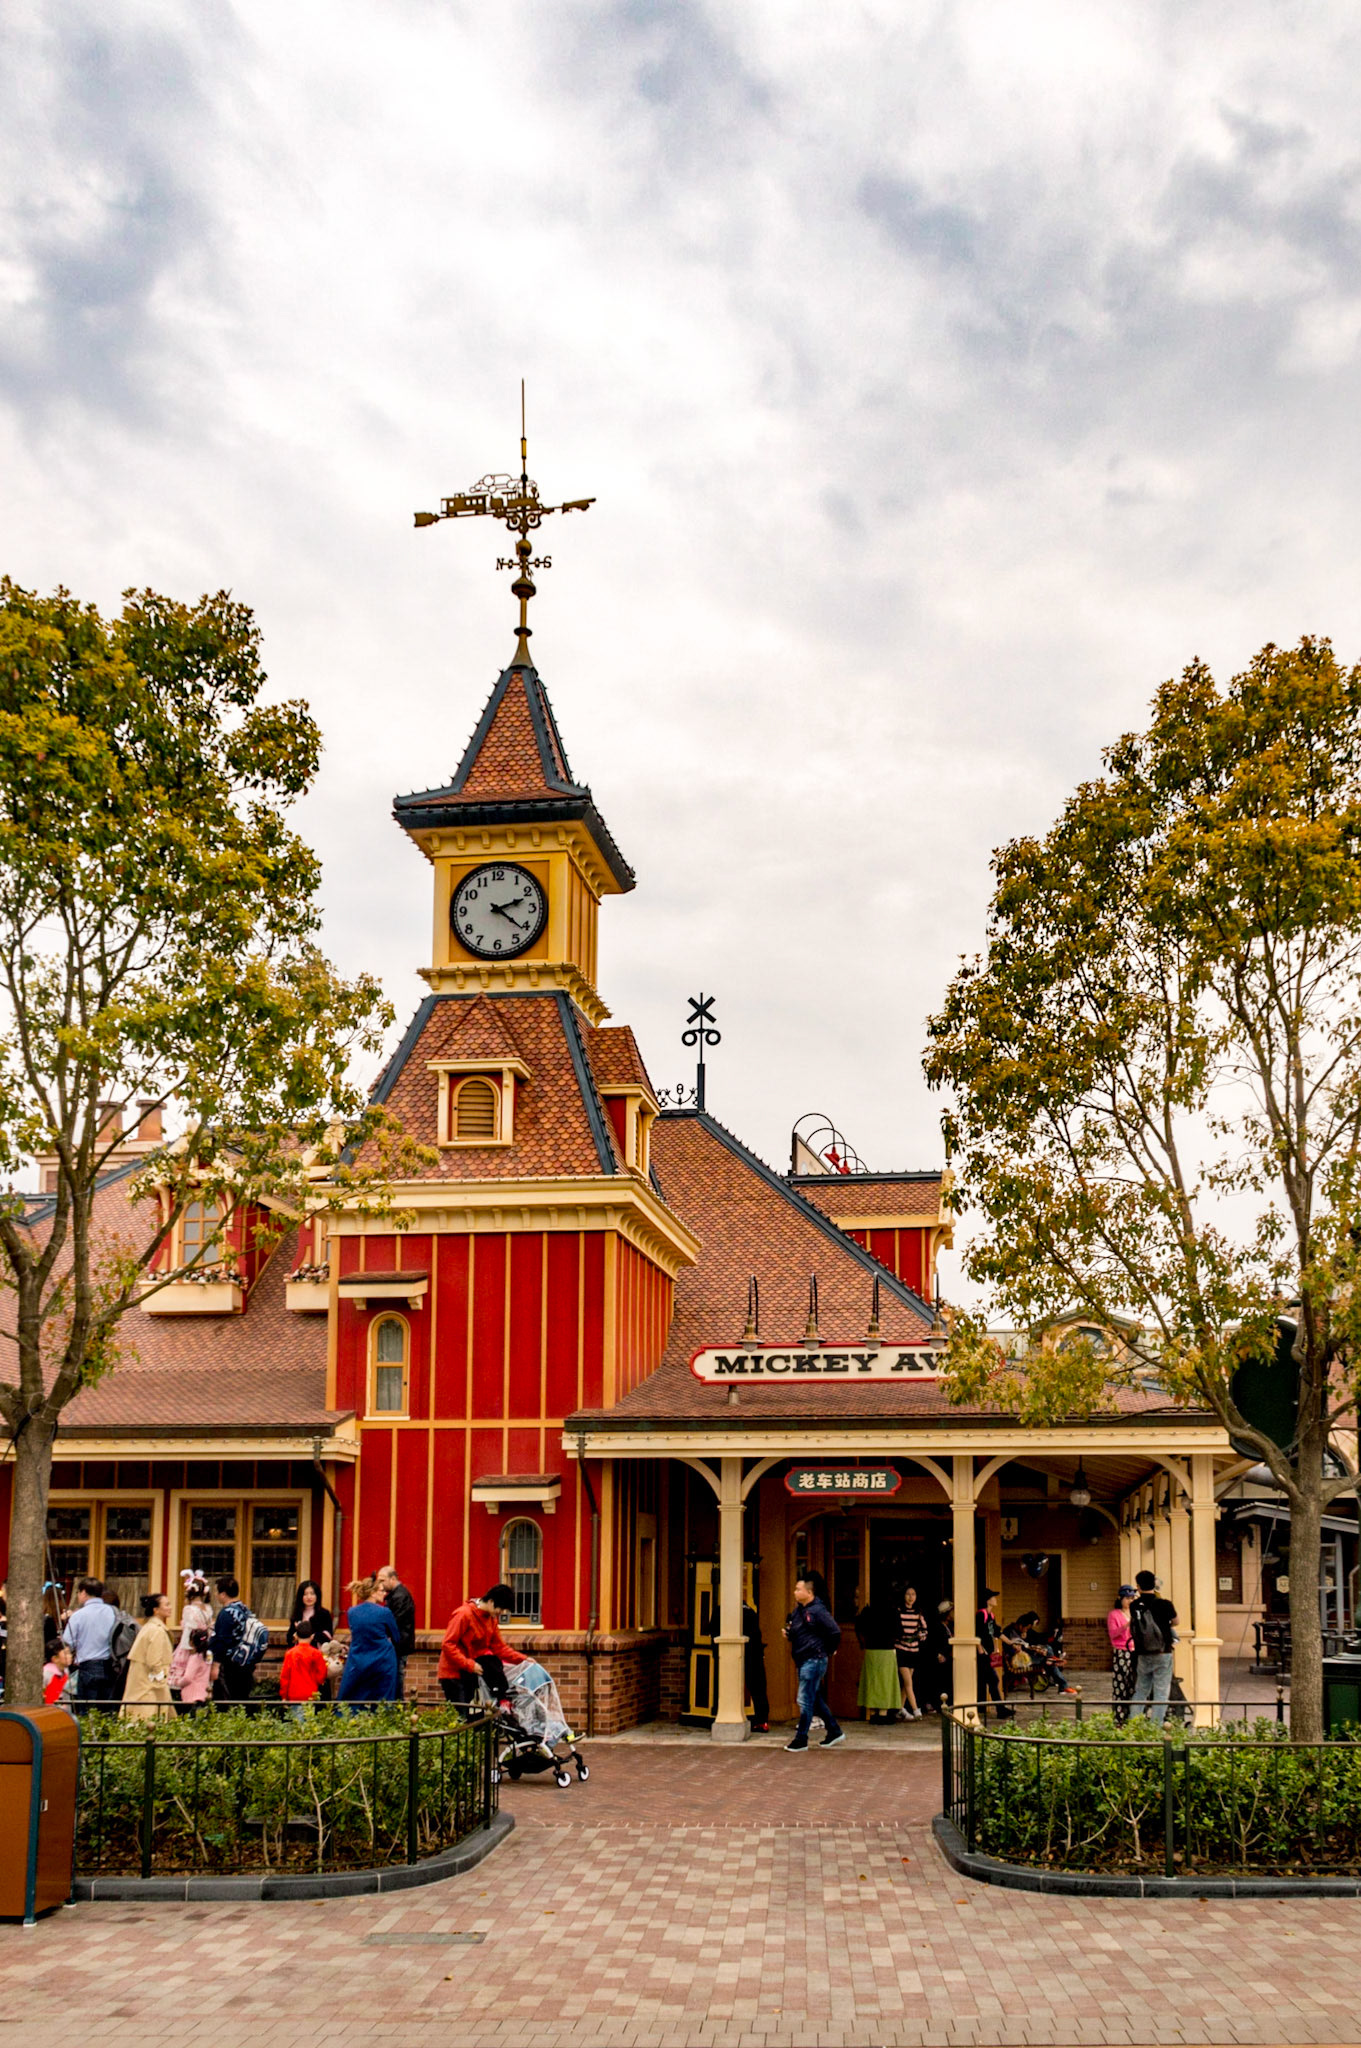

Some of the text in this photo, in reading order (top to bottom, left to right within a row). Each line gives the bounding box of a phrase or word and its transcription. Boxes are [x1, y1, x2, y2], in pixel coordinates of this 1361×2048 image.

[496, 557, 504, 570] N
[543, 555, 552, 568] S
[491, 870, 505, 881] 12
[514, 875, 519, 885] 1
[477, 877, 488, 887] 11
[464, 889, 478, 900] 10
[523, 886, 532, 897] 2
[459, 906, 467, 917] 9
[528, 902, 537, 913] 3
[464, 923, 473, 934] 8
[522, 920, 530, 931] 4
[476, 935, 484, 945] 7
[493, 939, 502, 950] 6
[511, 934, 520, 944] 5
[714, 1352, 955, 1374] MICKEY AV
[798, 1472, 887, 1489] 老车站商店
